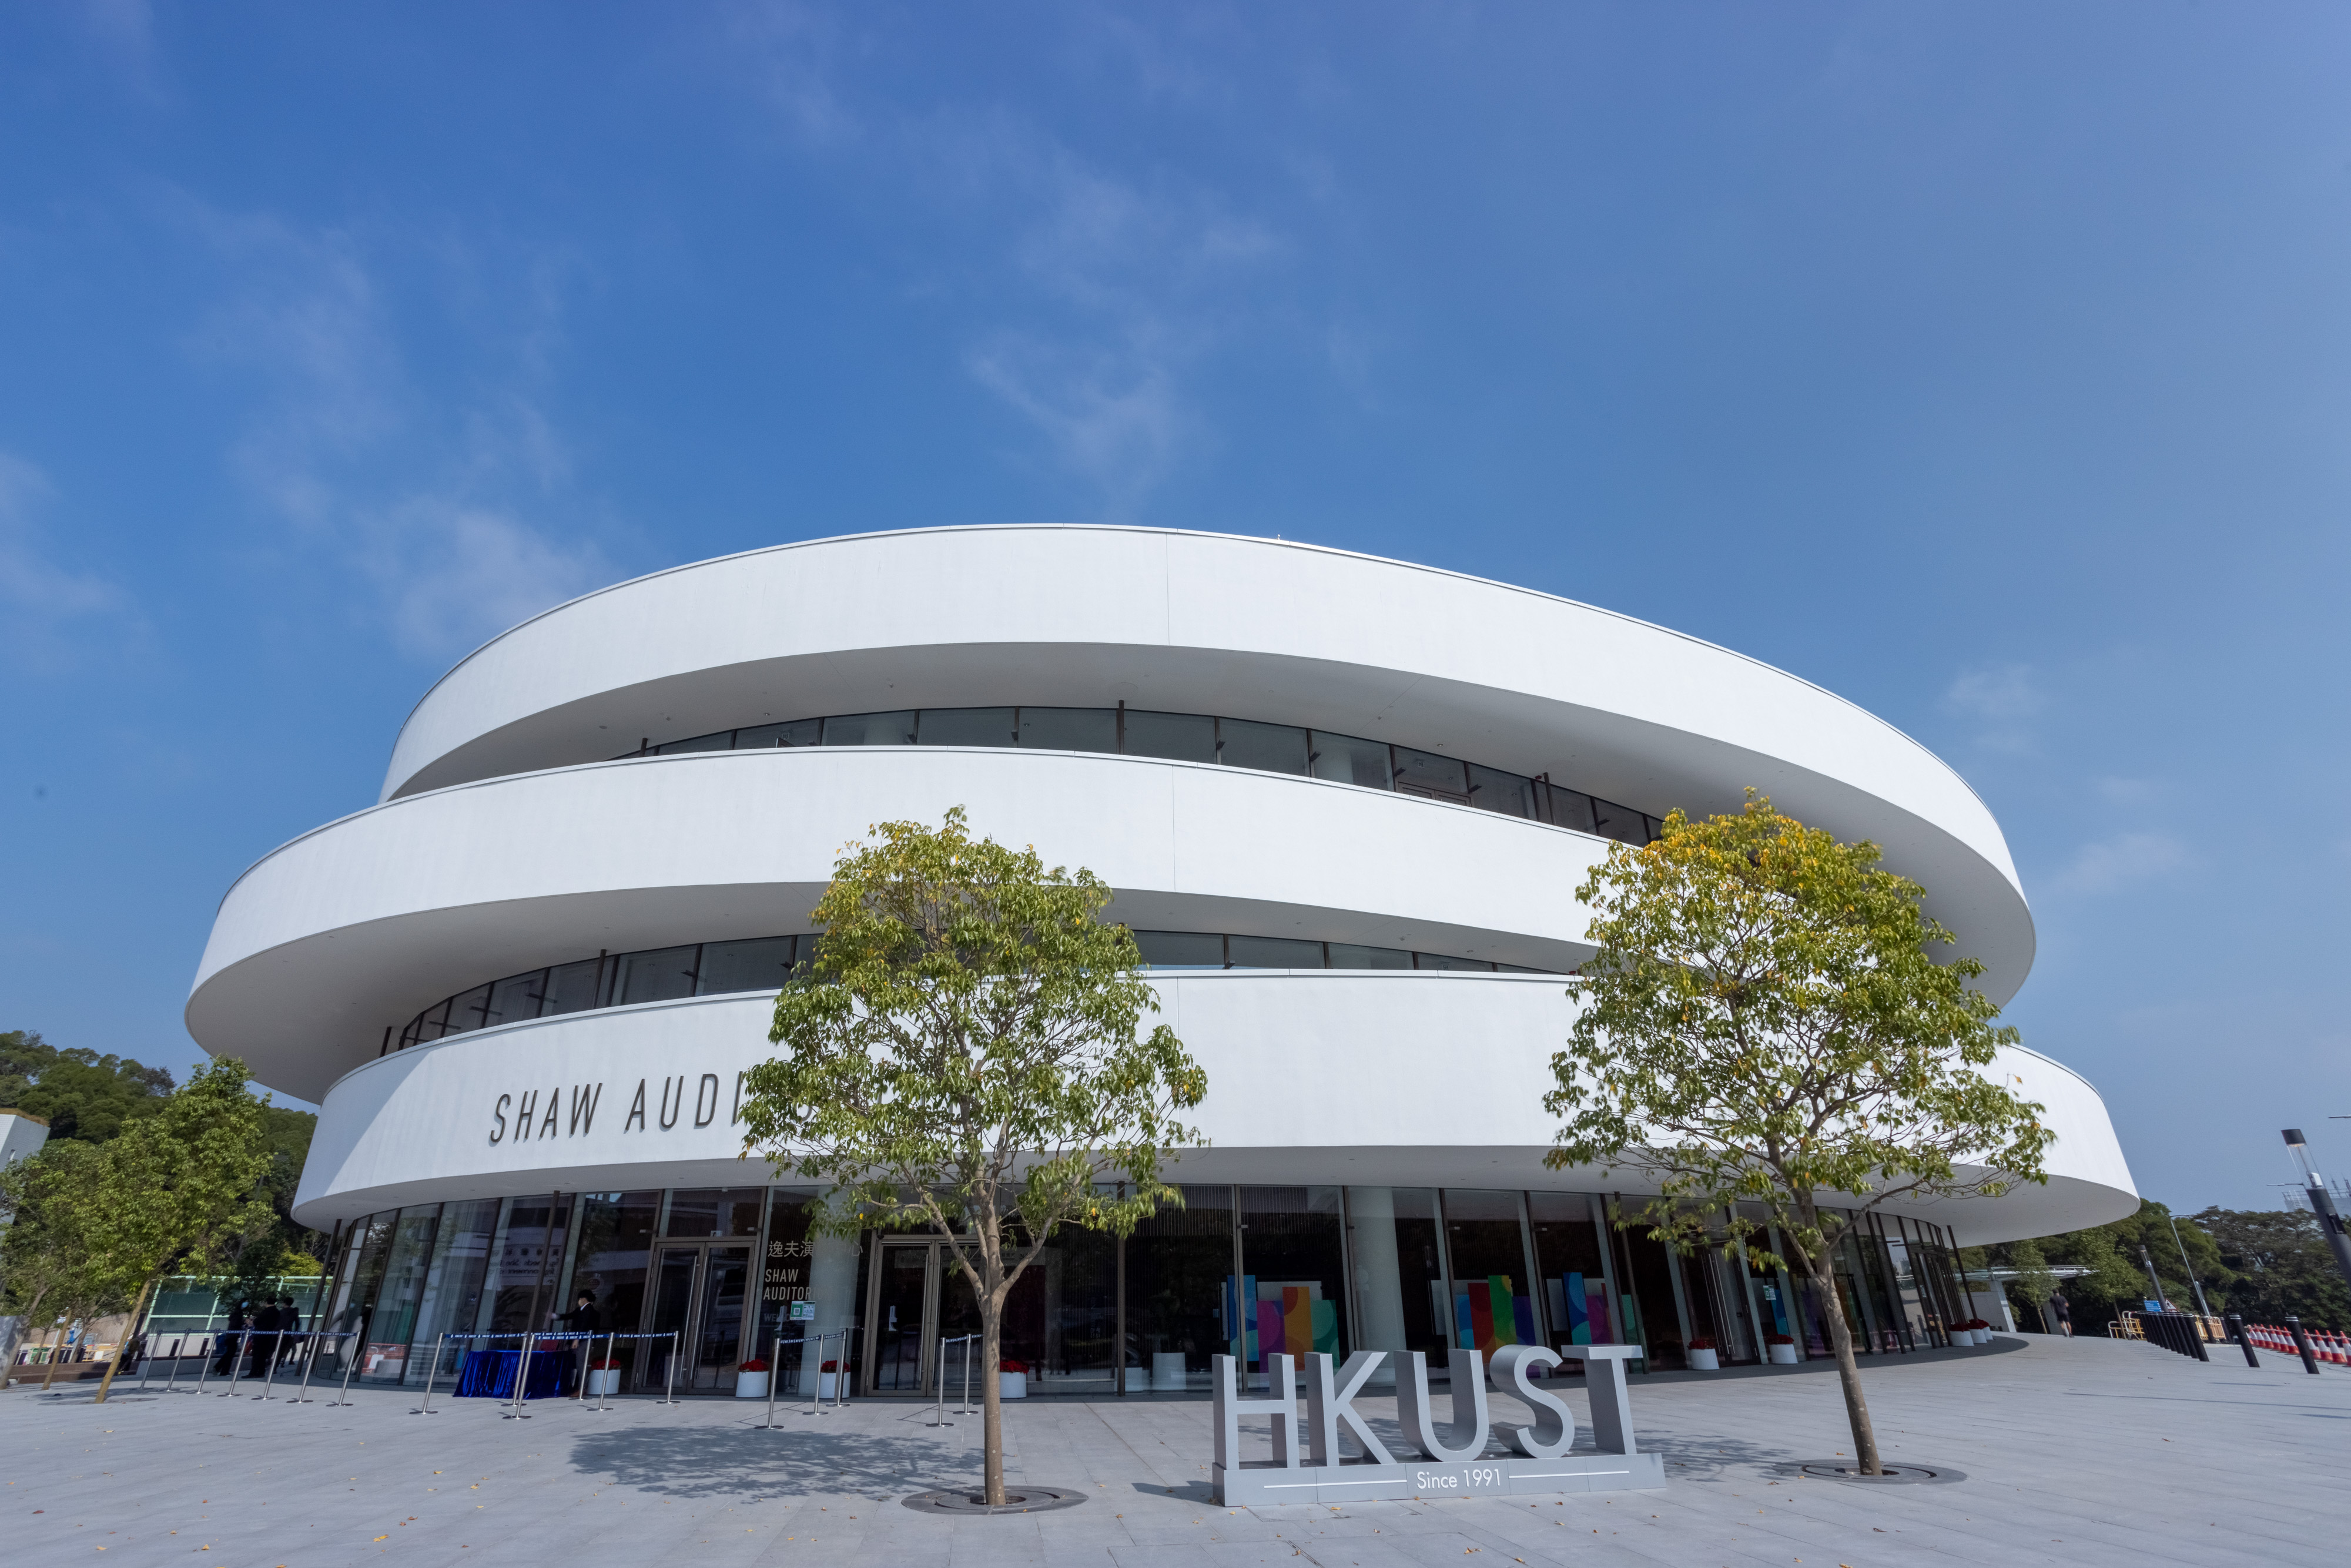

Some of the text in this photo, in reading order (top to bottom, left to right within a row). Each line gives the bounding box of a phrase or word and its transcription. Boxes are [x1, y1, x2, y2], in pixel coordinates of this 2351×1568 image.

[490, 1082, 603, 1143] SHAW
[765, 1268, 799, 1282] SHAW
[1213, 1343, 1643, 1470] HKUST
[1416, 1469, 1501, 1489] Since 1991
